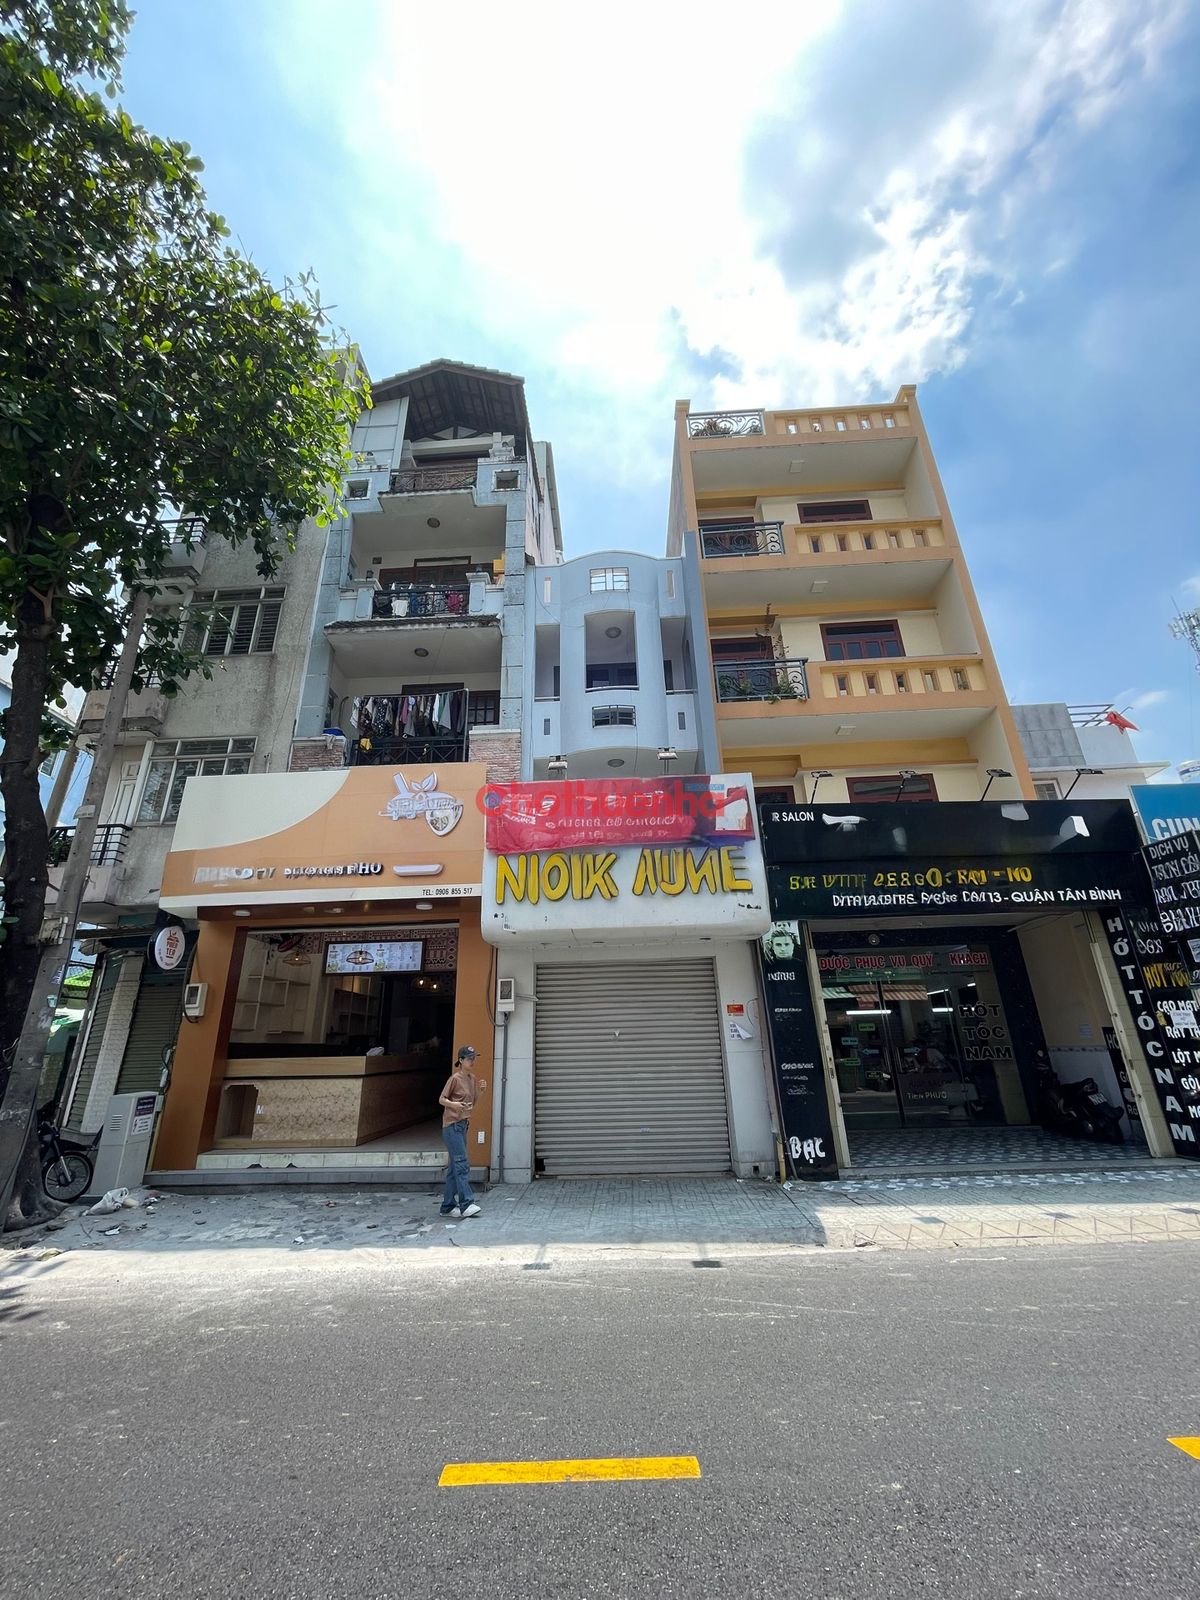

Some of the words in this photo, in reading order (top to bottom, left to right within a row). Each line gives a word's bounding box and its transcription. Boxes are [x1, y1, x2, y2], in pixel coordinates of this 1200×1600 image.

[782, 811, 815, 822] SALON
[1011, 888, 1055, 905] QUẬN
[1057, 887, 1086, 902] TÂN
[1089, 886, 1122, 901] BÌNH
[964, 1046, 1014, 1061] NAM
